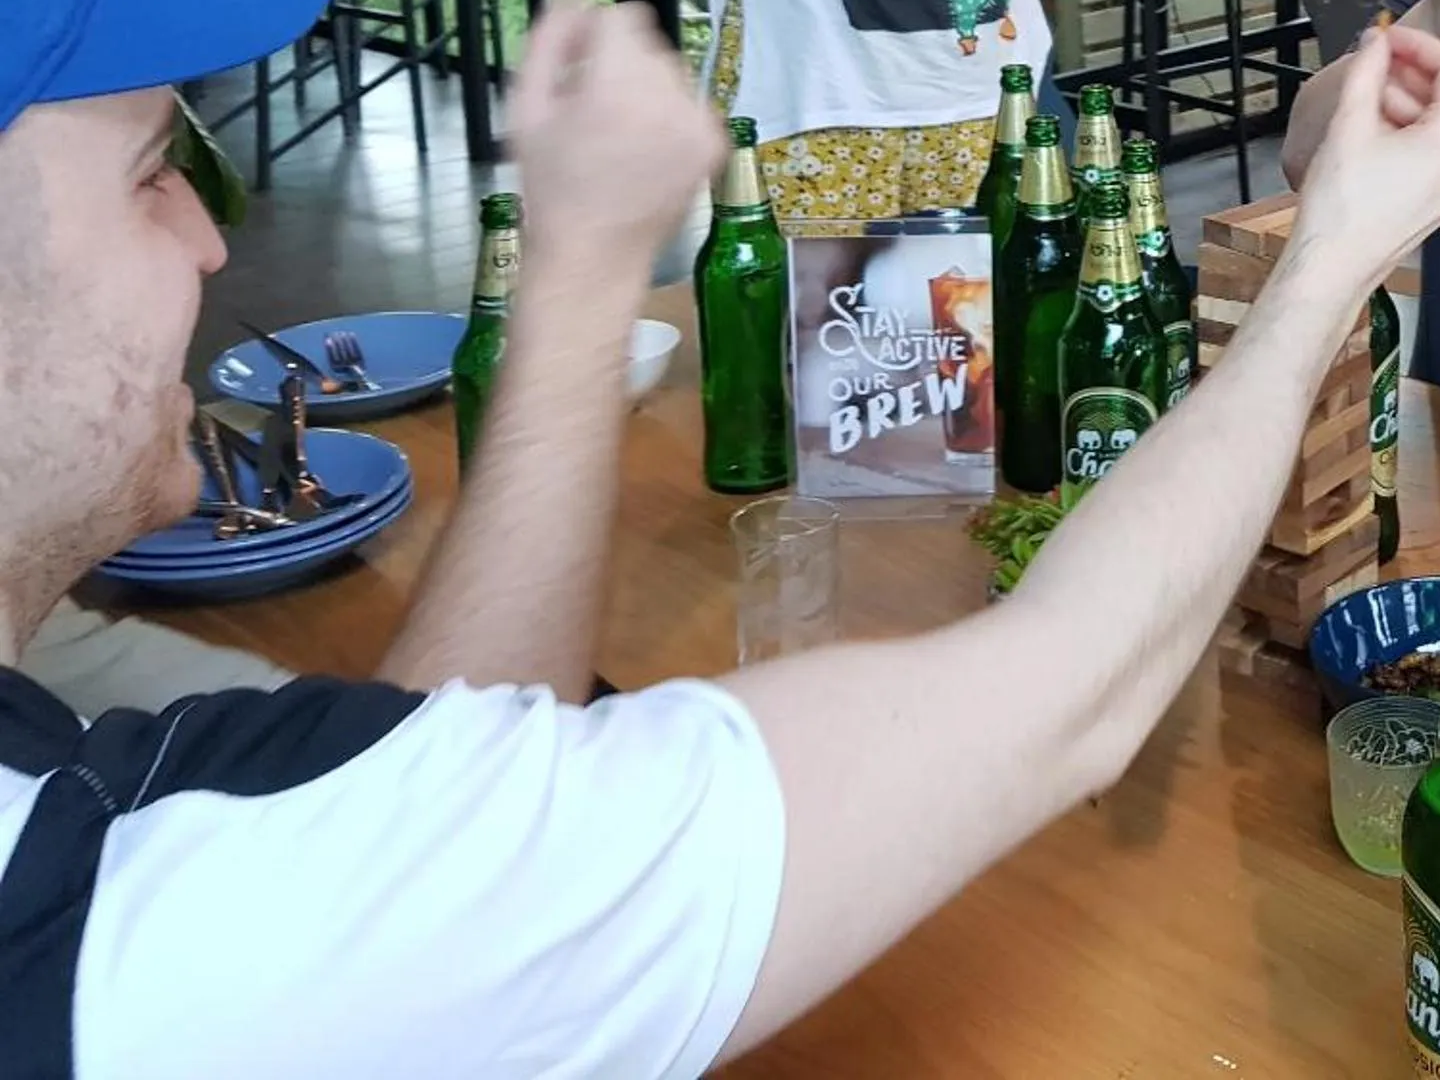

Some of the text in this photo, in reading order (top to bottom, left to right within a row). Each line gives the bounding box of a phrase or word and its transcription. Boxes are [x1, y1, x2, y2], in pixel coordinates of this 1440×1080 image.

[879, 328, 967, 361] ACTIVE
[828, 373, 894, 402] OUR
[829, 363, 968, 454] BREW
[1067, 448, 1116, 478] Cha
